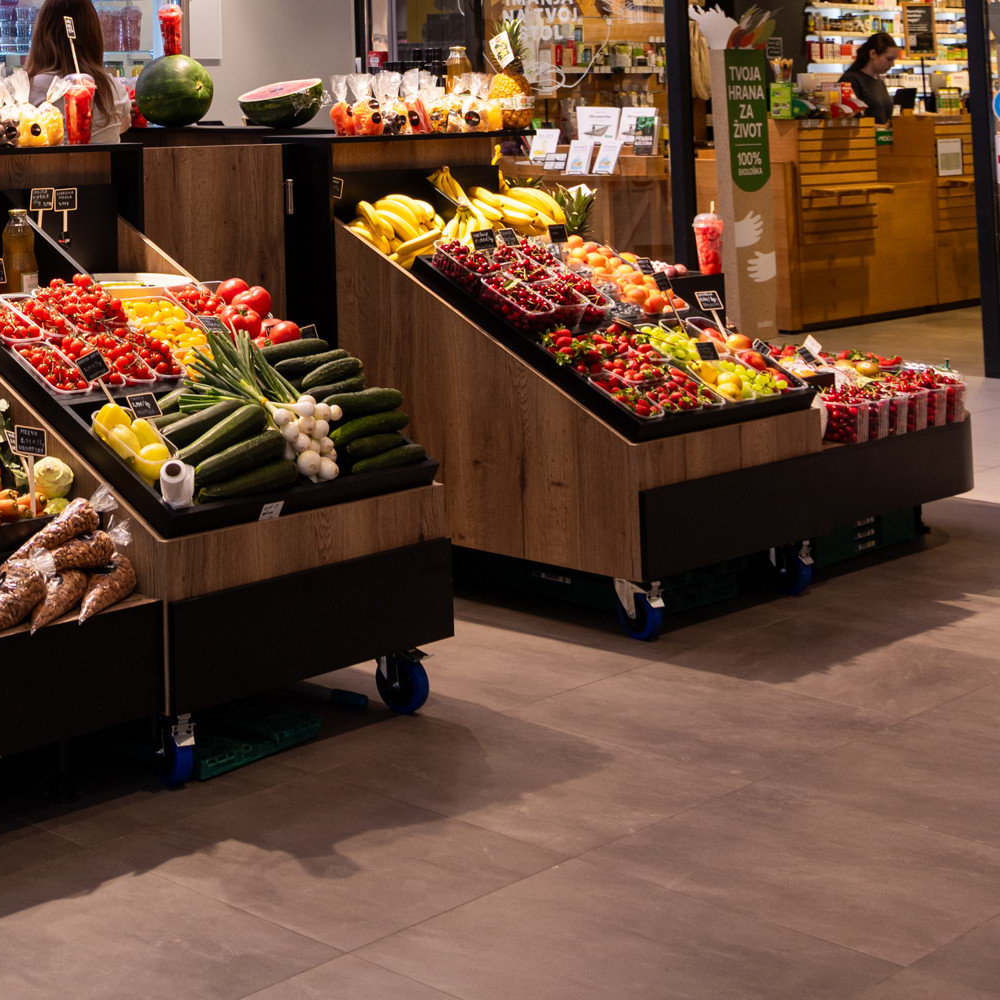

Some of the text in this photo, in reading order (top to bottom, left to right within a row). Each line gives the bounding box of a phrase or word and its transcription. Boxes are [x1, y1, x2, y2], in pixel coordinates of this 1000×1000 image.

[502, 7, 578, 24] NA TVOJ
[519, 24, 564, 41] STOL
[729, 66, 762, 81] TVOJA
[728, 85, 765, 100] HRANA
[739, 104, 754, 119] ZA
[733, 120, 763, 138] ŽIVOT
[737, 151, 762, 166] 100%
[738, 166, 763, 176] EKOLOŠKA
